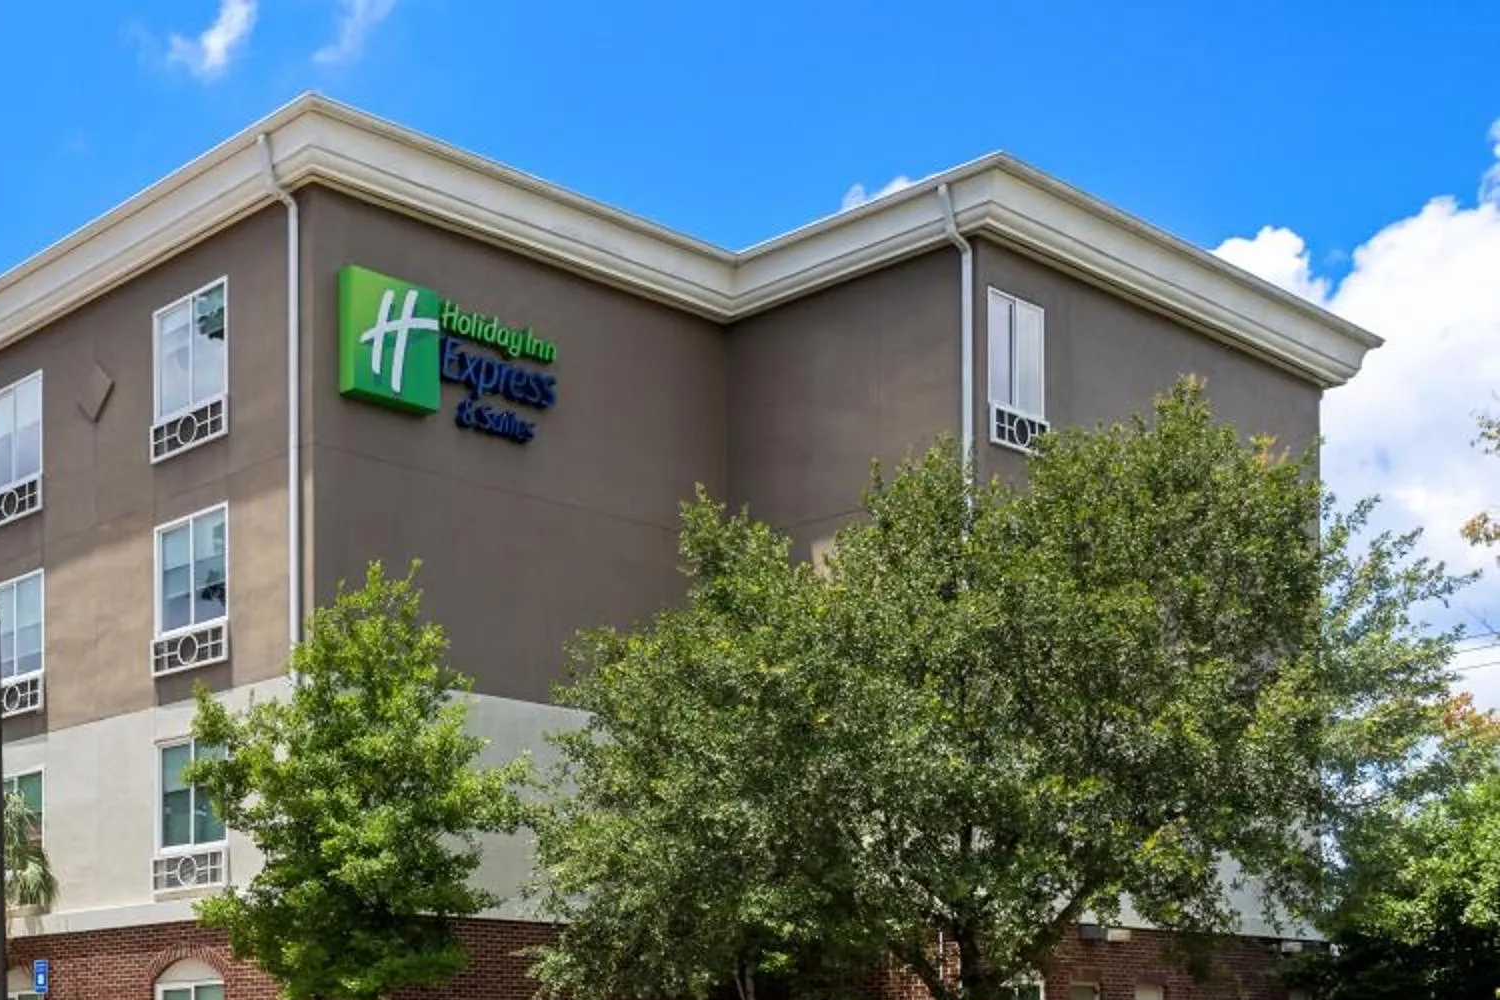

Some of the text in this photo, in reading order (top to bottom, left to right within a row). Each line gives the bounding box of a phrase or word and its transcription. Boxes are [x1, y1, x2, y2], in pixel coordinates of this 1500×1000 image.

[442, 299, 557, 361] Holiday Inn
[441, 336, 558, 407] Express
[456, 393, 536, 443] & Suites
